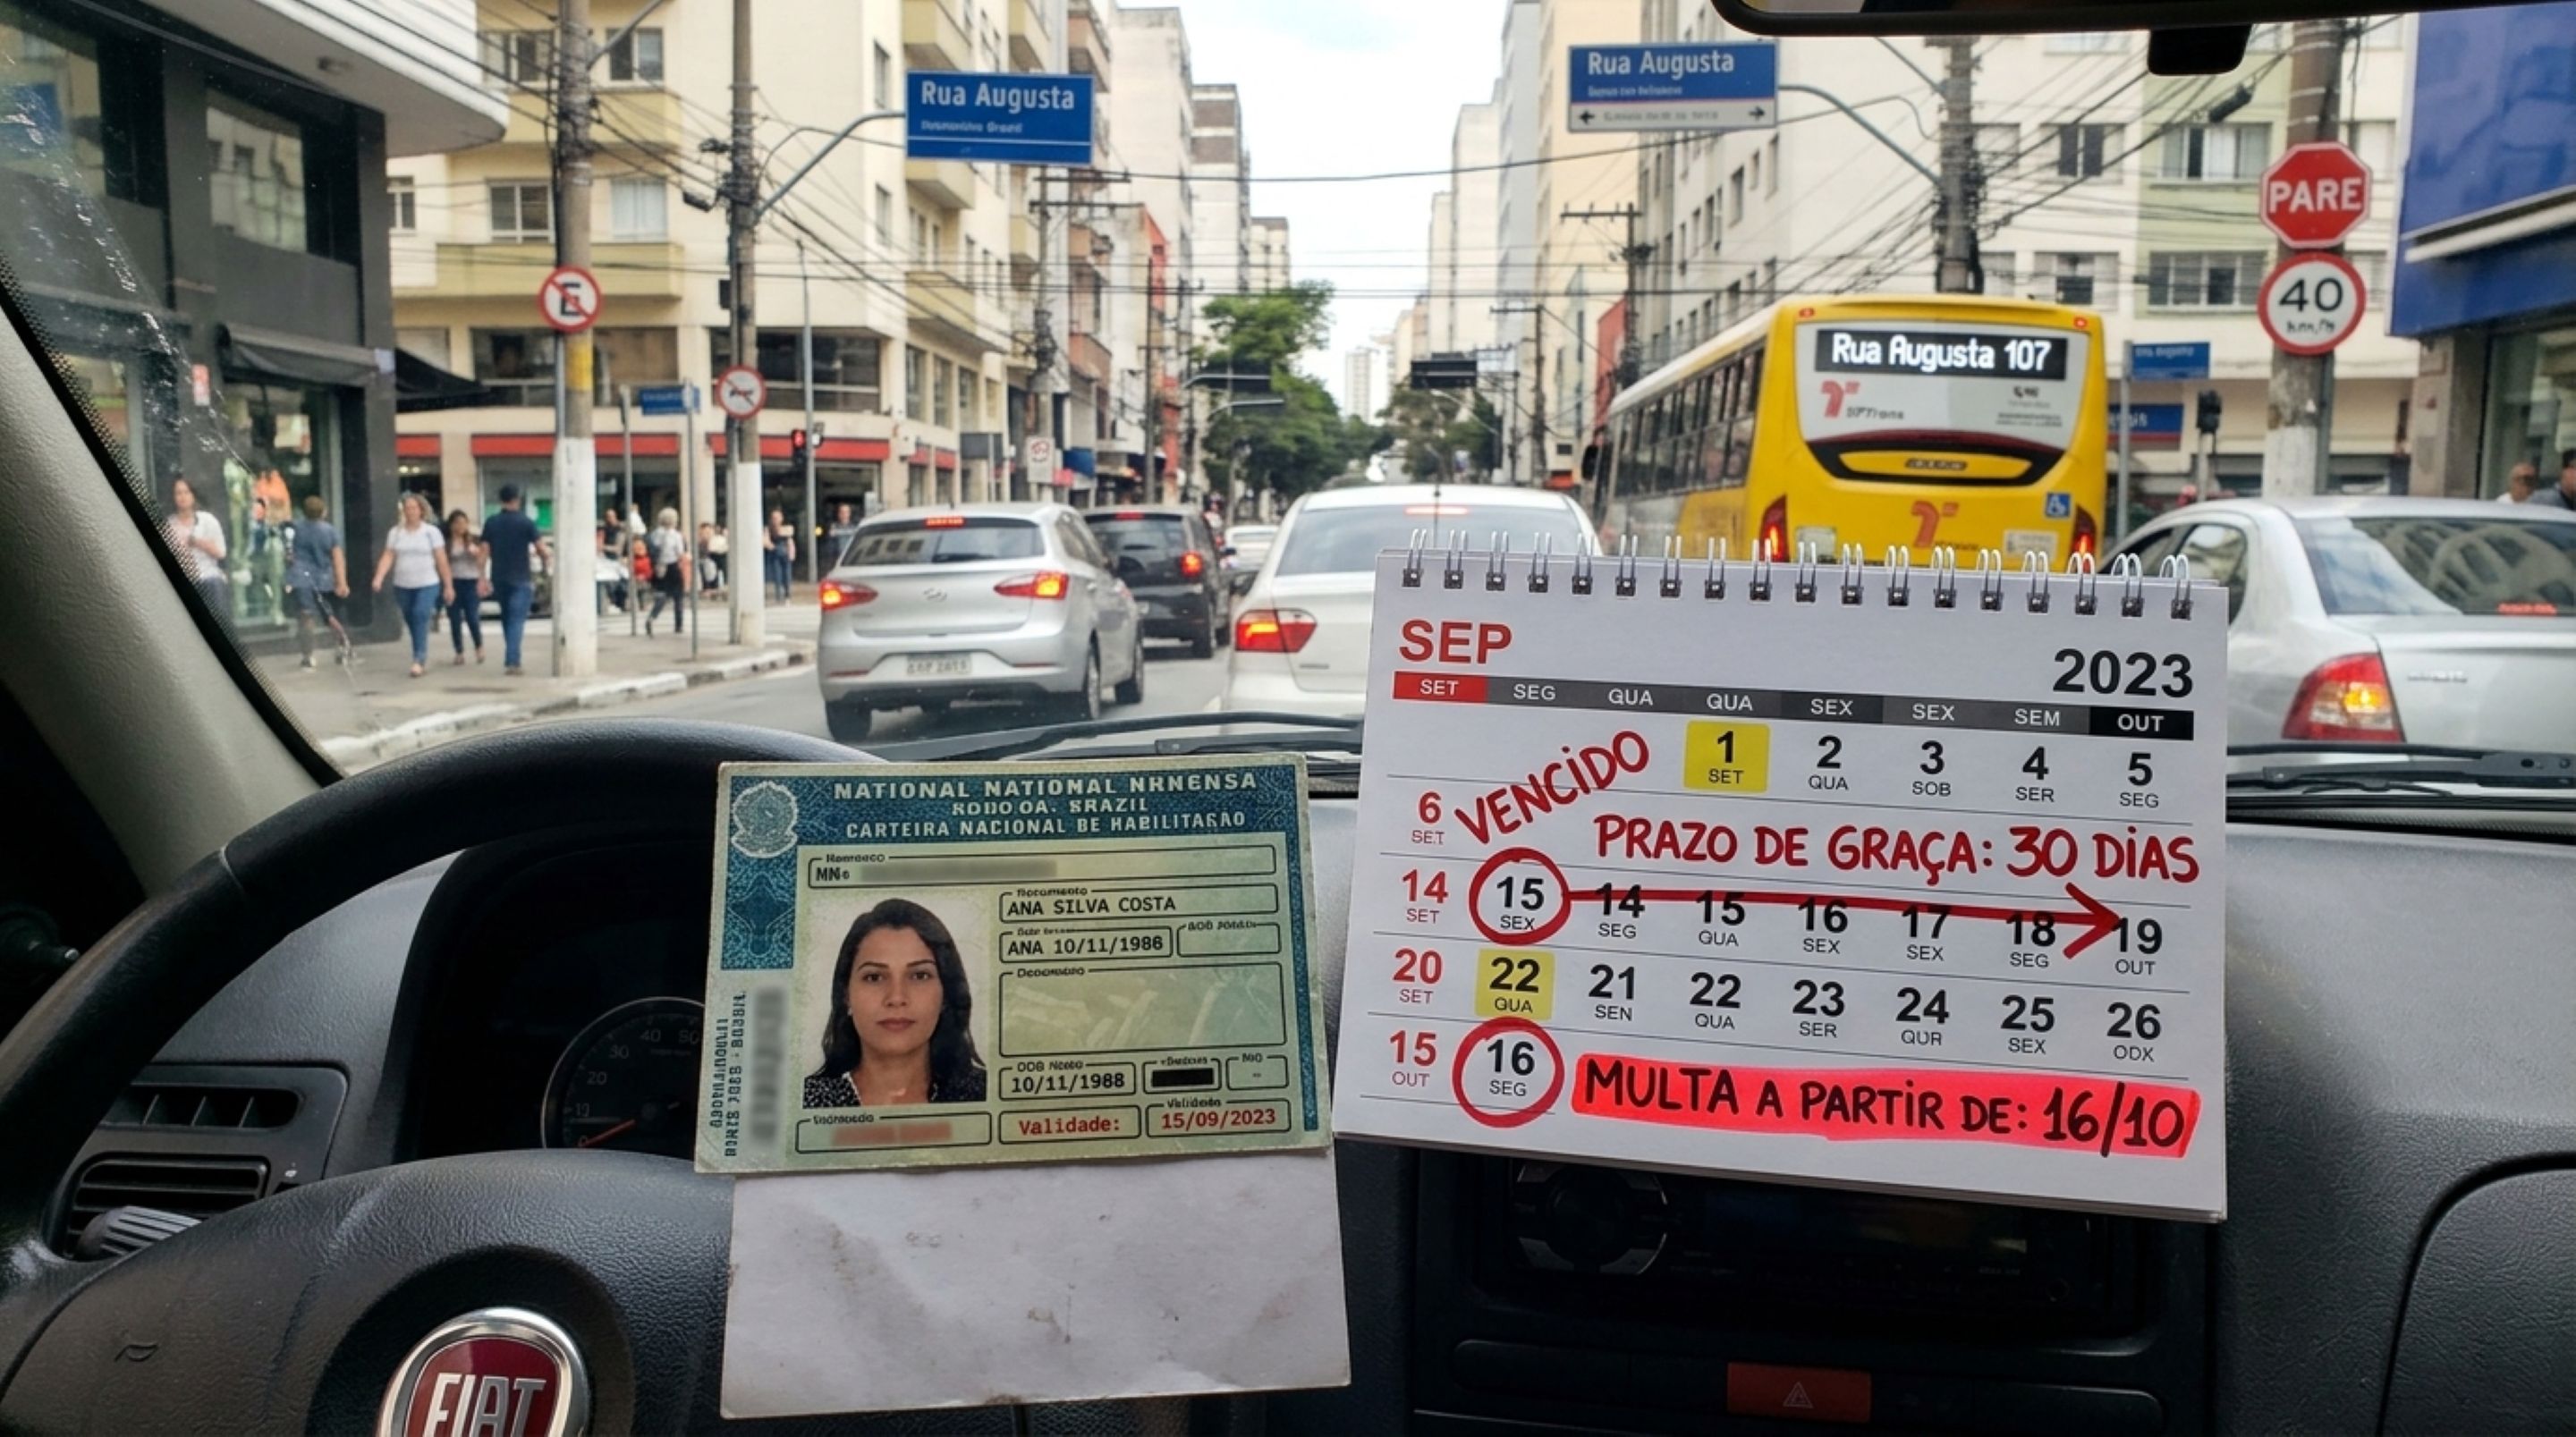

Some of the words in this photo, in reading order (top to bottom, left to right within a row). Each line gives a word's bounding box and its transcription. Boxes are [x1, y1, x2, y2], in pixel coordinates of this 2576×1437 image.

[1588, 51, 1631, 75] Rua
[1640, 49, 1734, 80] Augusta
[921, 80, 966, 106] Rua
[975, 82, 1075, 114] Augusta
[2268, 177, 2363, 213] PARE
[2279, 277, 2343, 312] 40
[1833, 333, 1882, 365] Rua
[1889, 334, 1996, 373] Augusta
[2004, 340, 2052, 371] 107
[1399, 619, 1513, 664] SEP
[2053, 648, 2193, 698] 2023
[1419, 679, 1459, 697] SET
[1513, 683, 1556, 701] SEG
[1608, 689, 1654, 707] QUA
[1810, 698, 1853, 716] SEX
[1912, 704, 1955, 722] SEX
[2014, 709, 2061, 727] SEM
[2118, 714, 2165, 732] OUT
[1716, 731, 1734, 764] 1
[1817, 735, 1843, 769] 2
[1919, 740, 1945, 775] 3
[2022, 746, 2050, 781] 4
[2128, 752, 2153, 787] 5
[1418, 791, 1442, 824] 6
[1707, 769, 1745, 784] SET
[1809, 774, 1849, 791] QUA
[1912, 781, 1952, 797] SOB
[2015, 786, 2055, 803] SER
[2119, 792, 2159, 808] SEG
[846, 820, 950, 839] CARTEIRA
[960, 818, 1066, 836] NACIONAL
[1411, 829, 1445, 845] SET
[1594, 815, 1738, 863] PRAZO
[1755, 825, 1809, 866] DE
[1827, 824, 1992, 886] GRAÇA:
[2006, 826, 2079, 877] 30
[1007, 900, 1044, 917] ANA
[1054, 898, 1109, 915] SILVA
[1118, 896, 1176, 912] COSTA
[1402, 868, 1448, 904] 14
[1496, 875, 1545, 910] 15
[1596, 882, 1646, 918] 14
[1696, 890, 1746, 926] 15
[1798, 899, 1848, 934] 16
[1902, 904, 1952, 939] 17
[2005, 910, 2056, 947] 18
[2112, 917, 2163, 955] 19
[1008, 939, 1044, 955] ANA
[1406, 908, 1440, 924] SET
[1500, 915, 1535, 931] SEX
[1598, 923, 1637, 940] SEG
[1699, 930, 1739, 947] QUA
[1802, 937, 1841, 954] SEX
[1906, 945, 1944, 961] SEX
[2009, 952, 2050, 968] SEG
[2114, 959, 2157, 975] OUT
[1393, 948, 1443, 984] 20
[1489, 956, 1540, 993] 22
[1589, 963, 1635, 1001] 21
[1690, 972, 1741, 1010] 22
[1792, 979, 1845, 1017] 23
[1895, 987, 1950, 1024] 24
[2001, 995, 2055, 1033] 25
[2107, 1002, 2162, 1040] 26
[1399, 988, 1434, 1004] SET
[1494, 997, 1534, 1014] QUA
[1595, 1004, 1633, 1021] SEN
[1695, 1013, 1736, 1030] QUA
[1799, 1022, 1837, 1038] SER
[2008, 1038, 2046, 1055] SEX
[2114, 1045, 2154, 1062] ODX
[1389, 1029, 1437, 1067] 15
[1487, 1038, 1536, 1077] 16
[587, 1071, 607, 1086] 20
[1012, 1072, 1125, 1095] 10/11/1988
[1392, 1071, 1429, 1087] OUT
[1489, 1080, 1527, 1097] SEG
[1018, 1115, 1121, 1136] Validade:
[1162, 1109, 1276, 1131] 15/09/2023
[1586, 1059, 1739, 1115] MULTA
[1756, 1080, 1784, 1119] A
[1960, 1095, 2028, 1134] DE:
[2043, 1080, 2185, 1158] 16/10
[422, 1372, 547, 1437] FIAT
